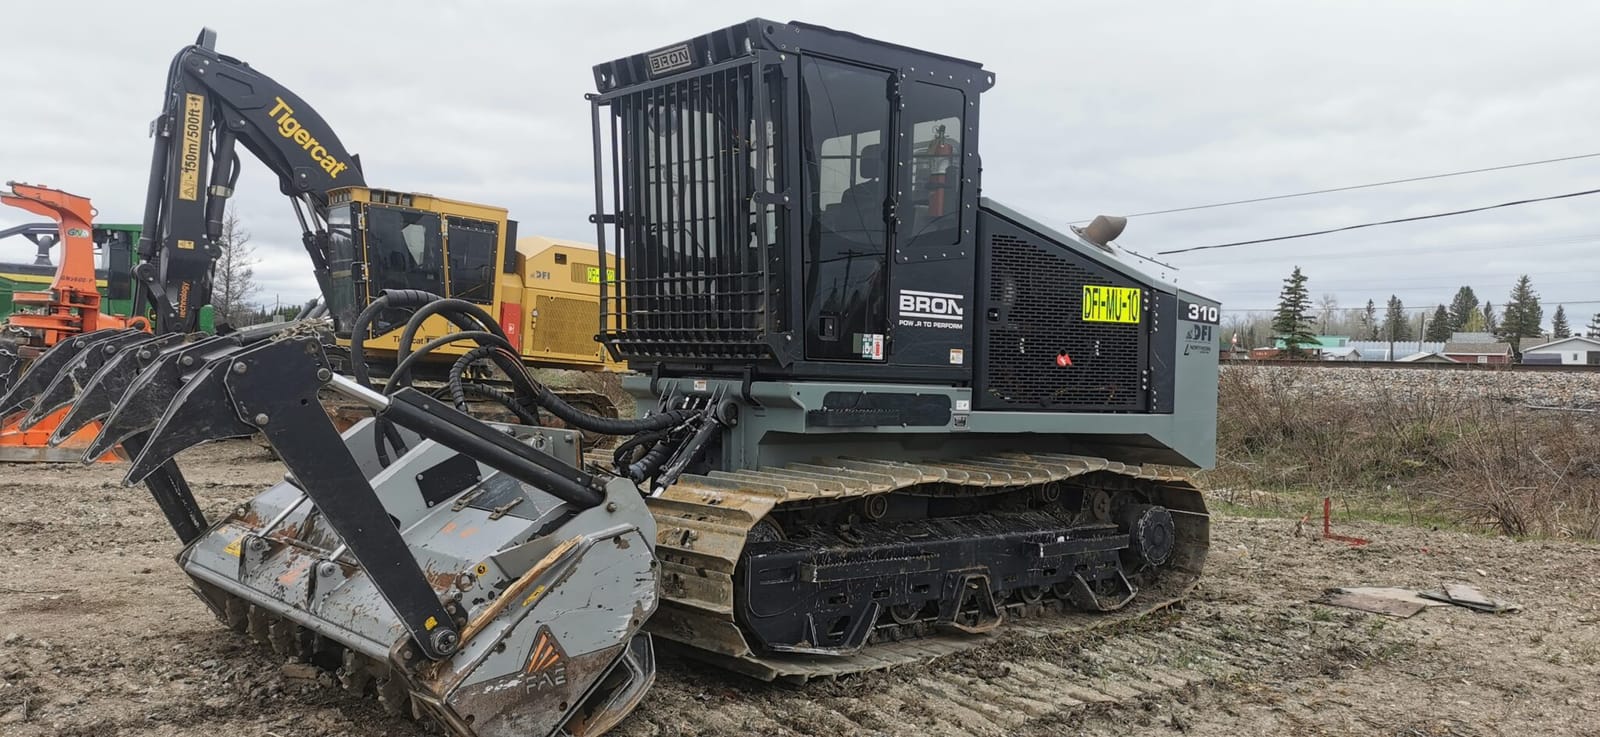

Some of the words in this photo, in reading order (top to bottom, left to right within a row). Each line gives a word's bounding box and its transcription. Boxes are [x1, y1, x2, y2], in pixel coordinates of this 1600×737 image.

[651, 50, 689, 69] BRON
[268, 96, 347, 178] Tigercat
[536, 270, 551, 280] DFI
[899, 294, 964, 315] BRON
[1084, 287, 1139, 322] DFI-MU-10
[1188, 303, 1218, 322] 310
[933, 322, 963, 330] PERFORM
[1193, 324, 1212, 341] DFI
[526, 667, 566, 694] FAE
